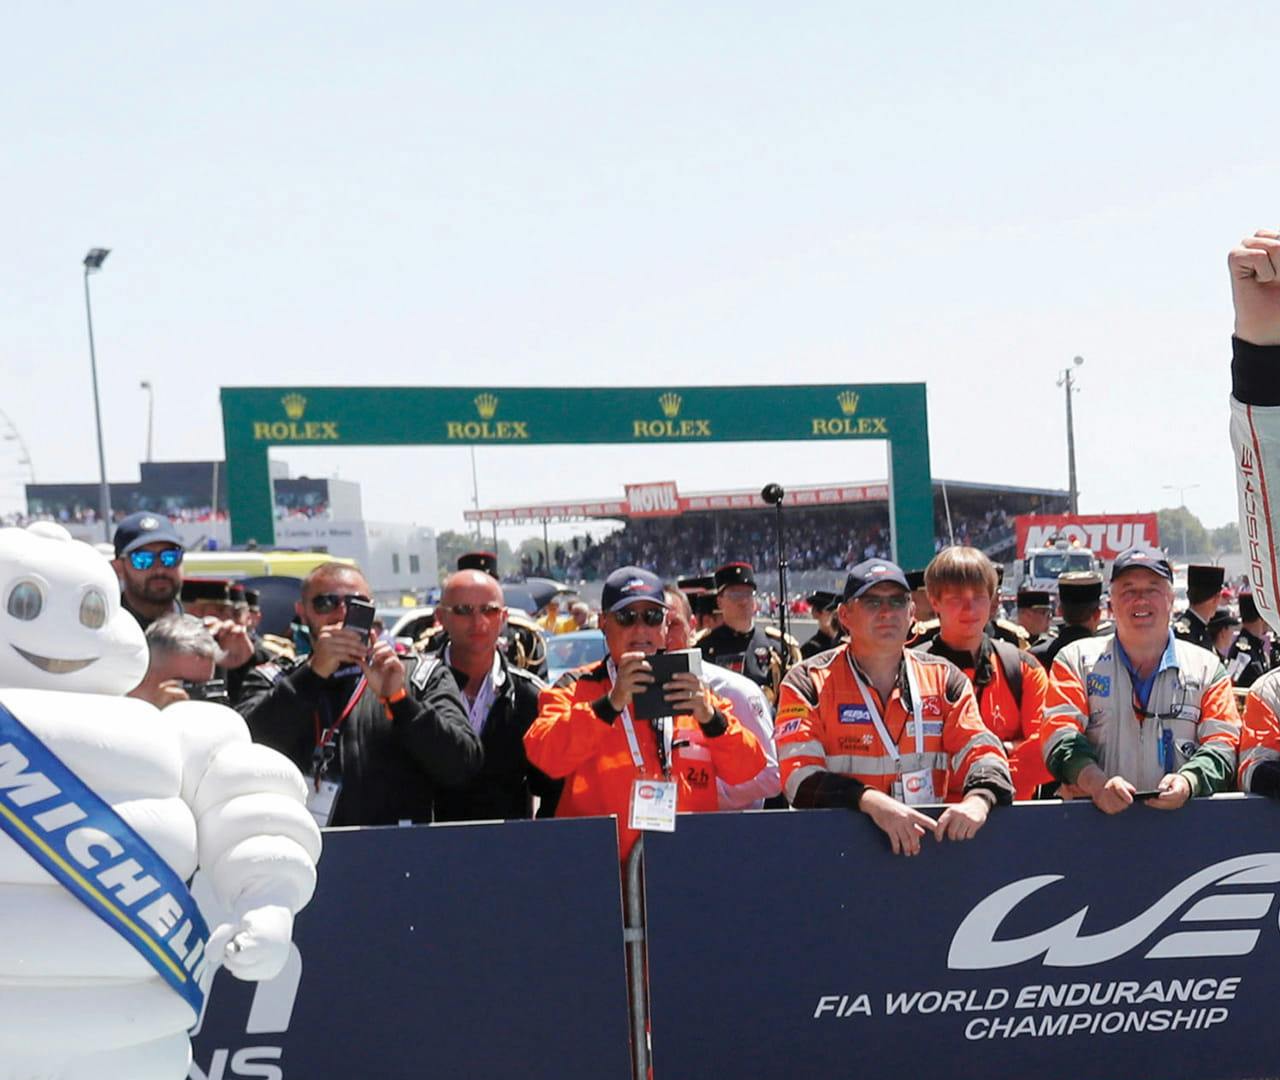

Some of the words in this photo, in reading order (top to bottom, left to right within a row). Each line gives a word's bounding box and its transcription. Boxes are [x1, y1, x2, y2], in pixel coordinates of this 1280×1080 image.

[254, 422, 339, 440] ROLEX
[447, 421, 528, 439] ROLEX
[633, 420, 711, 437] ROLEX
[812, 417, 889, 435] ROLEX
[1023, 523, 1153, 551] MOTUL
[814, 995, 873, 1018] FIA
[884, 988, 1010, 1015] WORLD
[1014, 976, 1242, 1009] ENDURANCE
[964, 1007, 1229, 1041] CHAMPIONSHIP
